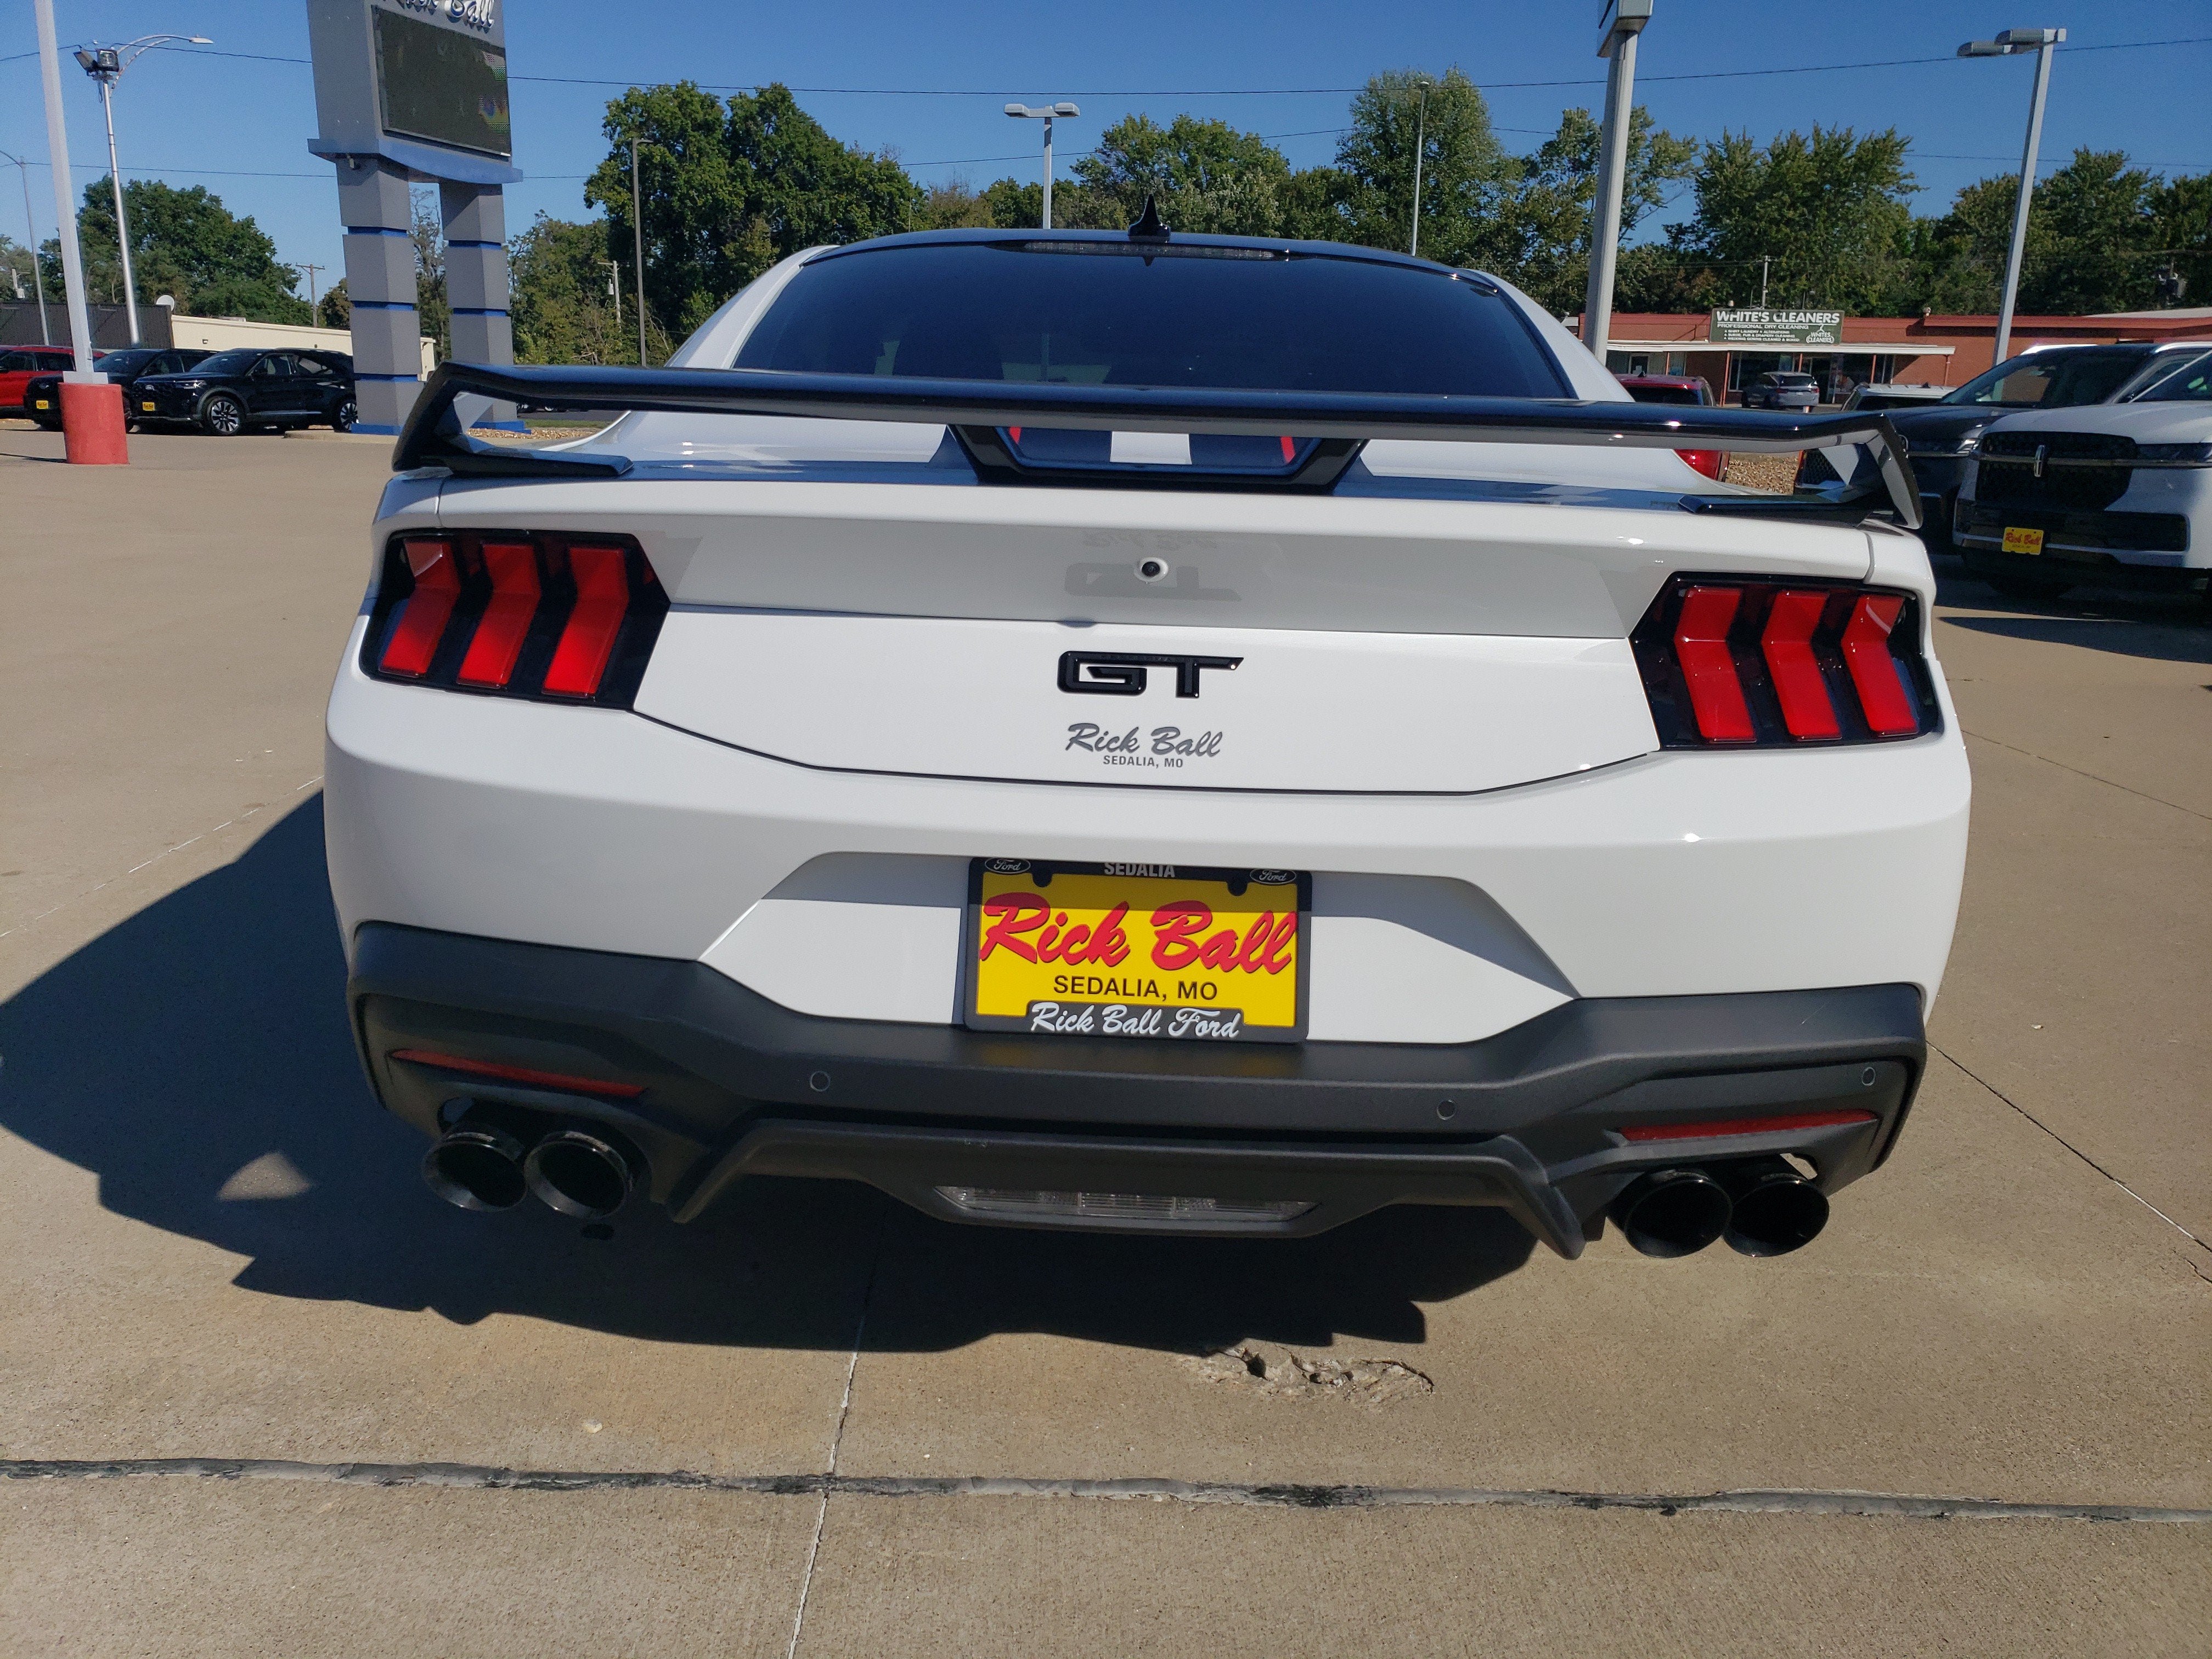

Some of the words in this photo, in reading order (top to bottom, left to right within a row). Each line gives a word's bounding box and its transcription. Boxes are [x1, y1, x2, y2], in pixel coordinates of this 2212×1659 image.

[1716, 311, 1770, 323] WHITE'S
[1773, 312, 1840, 324] CLEANERS
[1057, 651, 1244, 698] GT
[1065, 723, 1140, 753] Rick
[1150, 726, 1223, 757] Ball
[1103, 754, 1159, 769] SEDALIA,
[1164, 758, 1183, 768] MO
[993, 858, 1022, 872] Ford
[1104, 862, 1175, 878] SEDALIA
[1259, 868, 1286, 882] Ford
[979, 891, 1131, 967] Rick
[1150, 900, 1297, 974] Ball
[1053, 975, 1167, 1002] SEDALIA,
[1177, 981, 1218, 1001] MO
[1030, 1002, 1096, 1032] Rick
[1102, 1003, 1161, 1036] Ball
[1167, 1007, 1240, 1039] Ford
